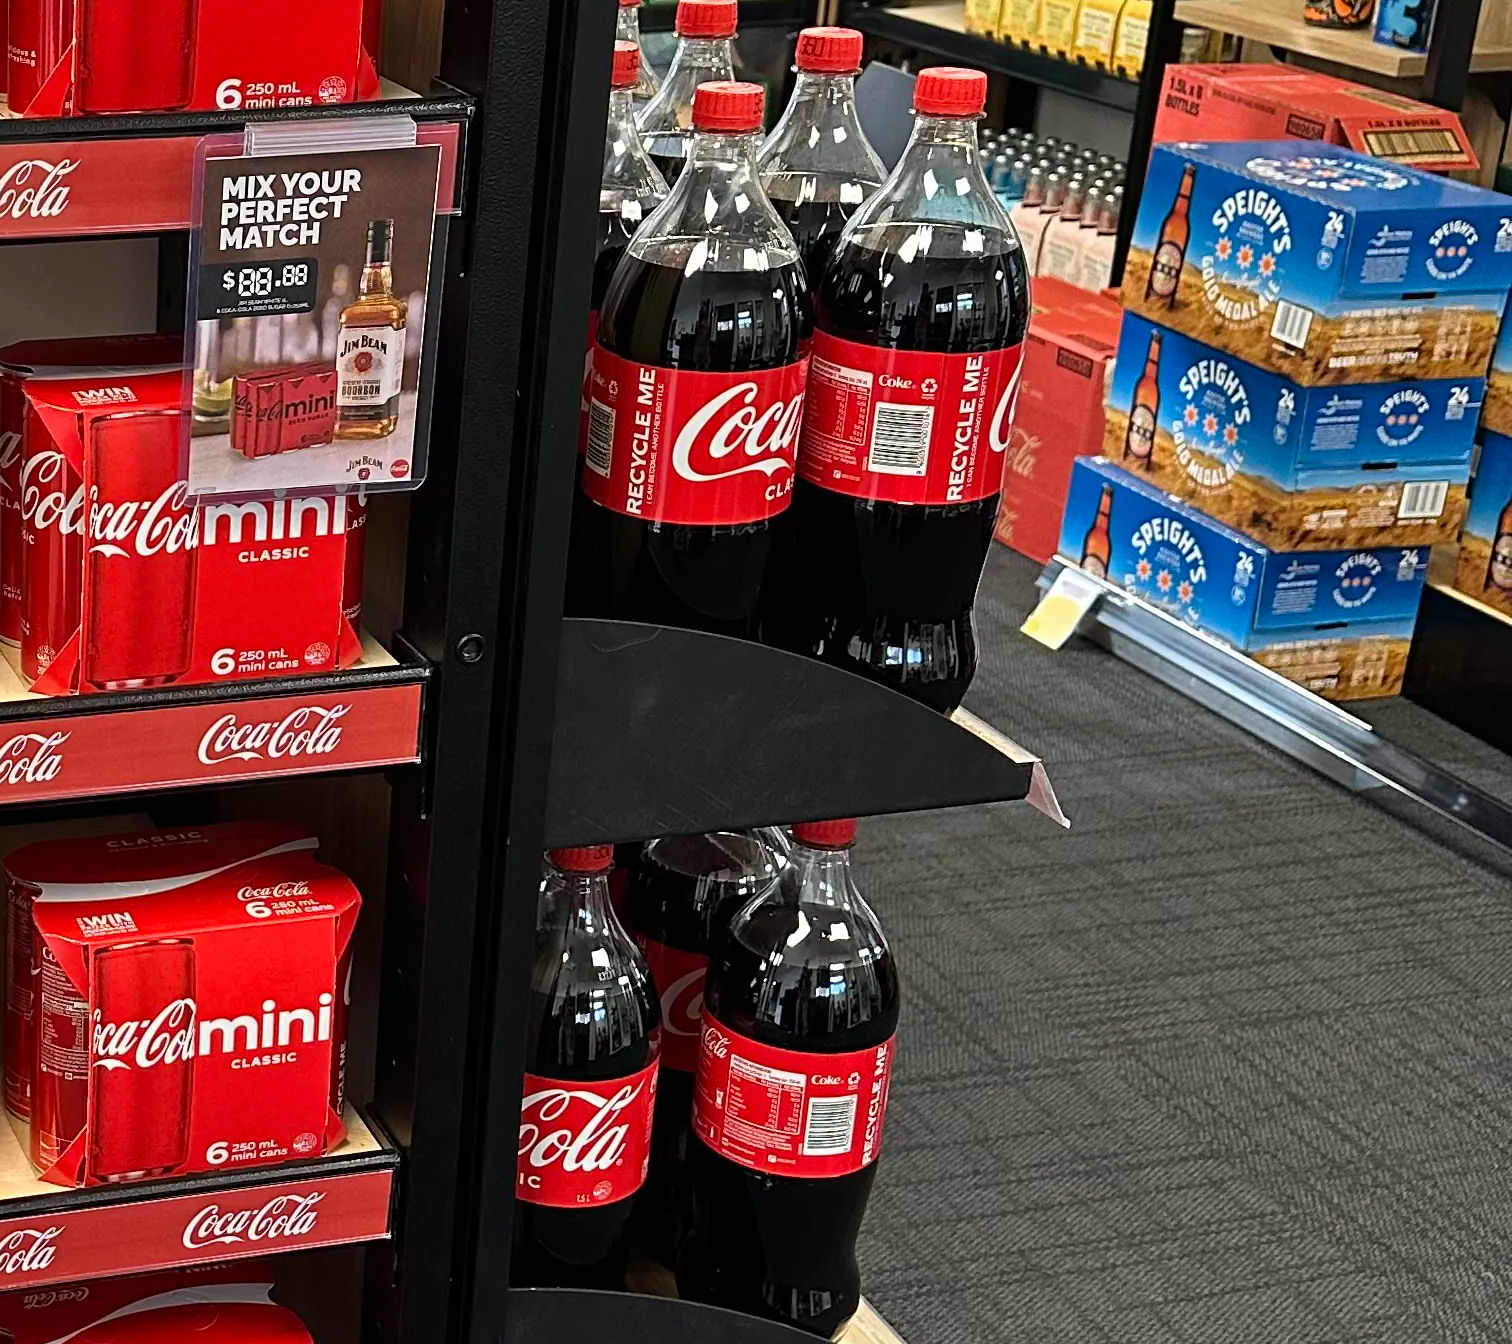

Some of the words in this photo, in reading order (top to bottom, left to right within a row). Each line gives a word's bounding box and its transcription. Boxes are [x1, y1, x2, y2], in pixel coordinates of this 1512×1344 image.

[215, 78, 242, 110] 6
[246, 83, 275, 95] 250
[278, 81, 300, 94] mL
[222, 174, 276, 200] MIX
[280, 169, 361, 196] YOUR
[221, 195, 348, 226] PERFECT
[1212, 189, 1291, 254] SPEIGHT'S
[219, 222, 320, 251] MATCH
[1429, 220, 1479, 247] SPEIGHT'S
[1215, 296, 1258, 320] MEDAL
[340, 340, 359, 357] JIM
[361, 335, 388, 354] BEAM
[637, 368, 655, 406] ME
[878, 374, 912, 389] Coke
[1179, 359, 1251, 425] SPEIGHT'S
[284, 390, 334, 417] mini
[1379, 389, 1430, 415] SPEIGHT'S
[946, 398, 976, 501] RECYCLE
[963, 356, 983, 393] ME
[626, 411, 651, 514] RECYCLE
[199, 485, 346, 546] mini
[238, 547, 309, 563] CLASSIC
[1132, 517, 1207, 584] SPEIGHT'S
[1336, 553, 1382, 577] SPEIGHT'S
[199, 705, 351, 764] Coca-Cola
[199, 993, 330, 1056] mini
[231, 1052, 297, 1069] CLASSIC
[811, 1074, 840, 1086] Coke
[861, 1079, 881, 1165] RECYCLE
[876, 1044, 888, 1075] ME
[183, 1193, 325, 1248] Coca-Cola
